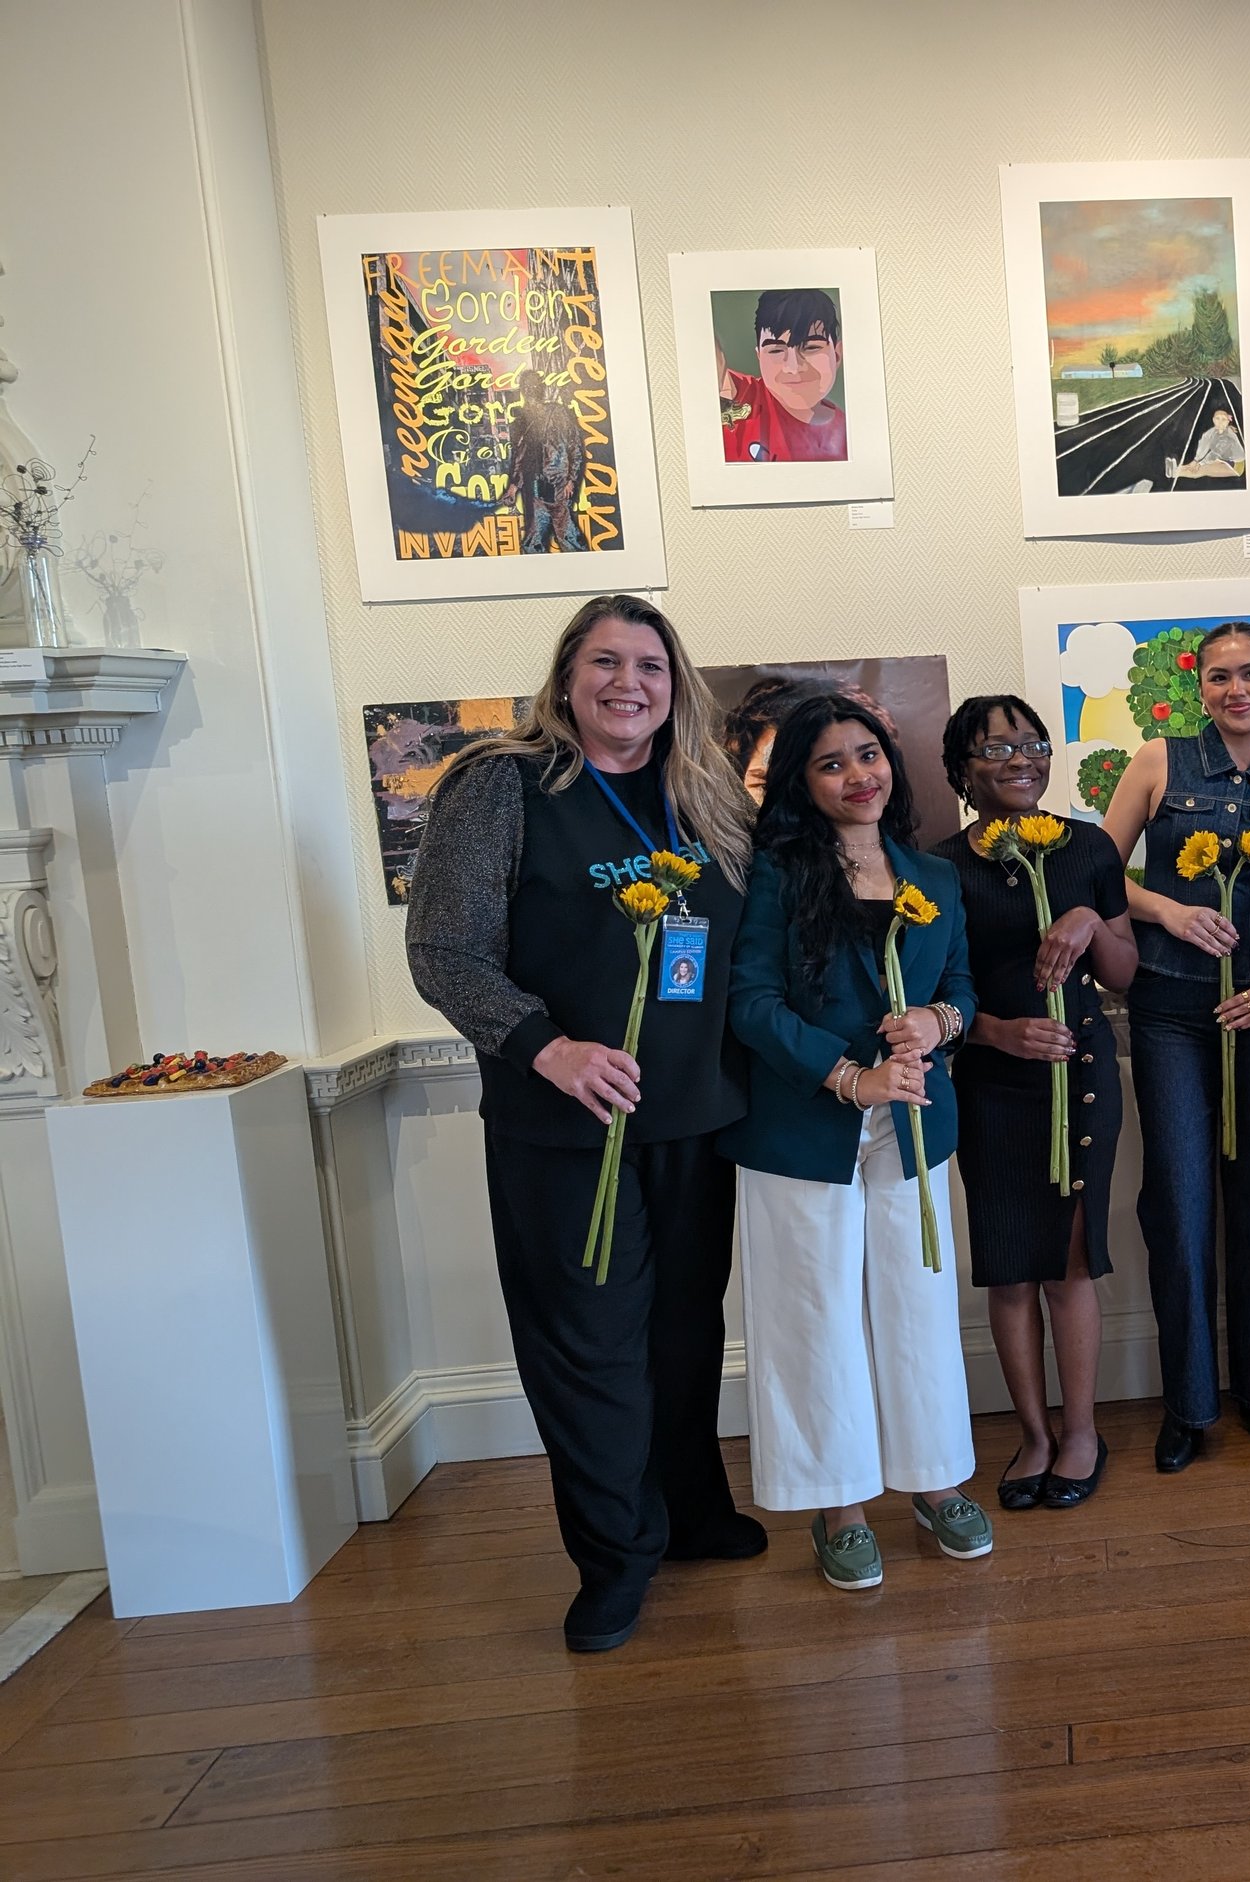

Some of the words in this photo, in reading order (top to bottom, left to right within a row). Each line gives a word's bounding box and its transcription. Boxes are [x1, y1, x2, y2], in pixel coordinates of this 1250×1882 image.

[363, 249, 561, 296] FREEMAN
[421, 275, 573, 324] Gorden
[413, 323, 561, 368] Gorden
[378, 289, 430, 483] reeman
[414, 361, 571, 398] Gordn
[427, 425, 512, 465] Gor
